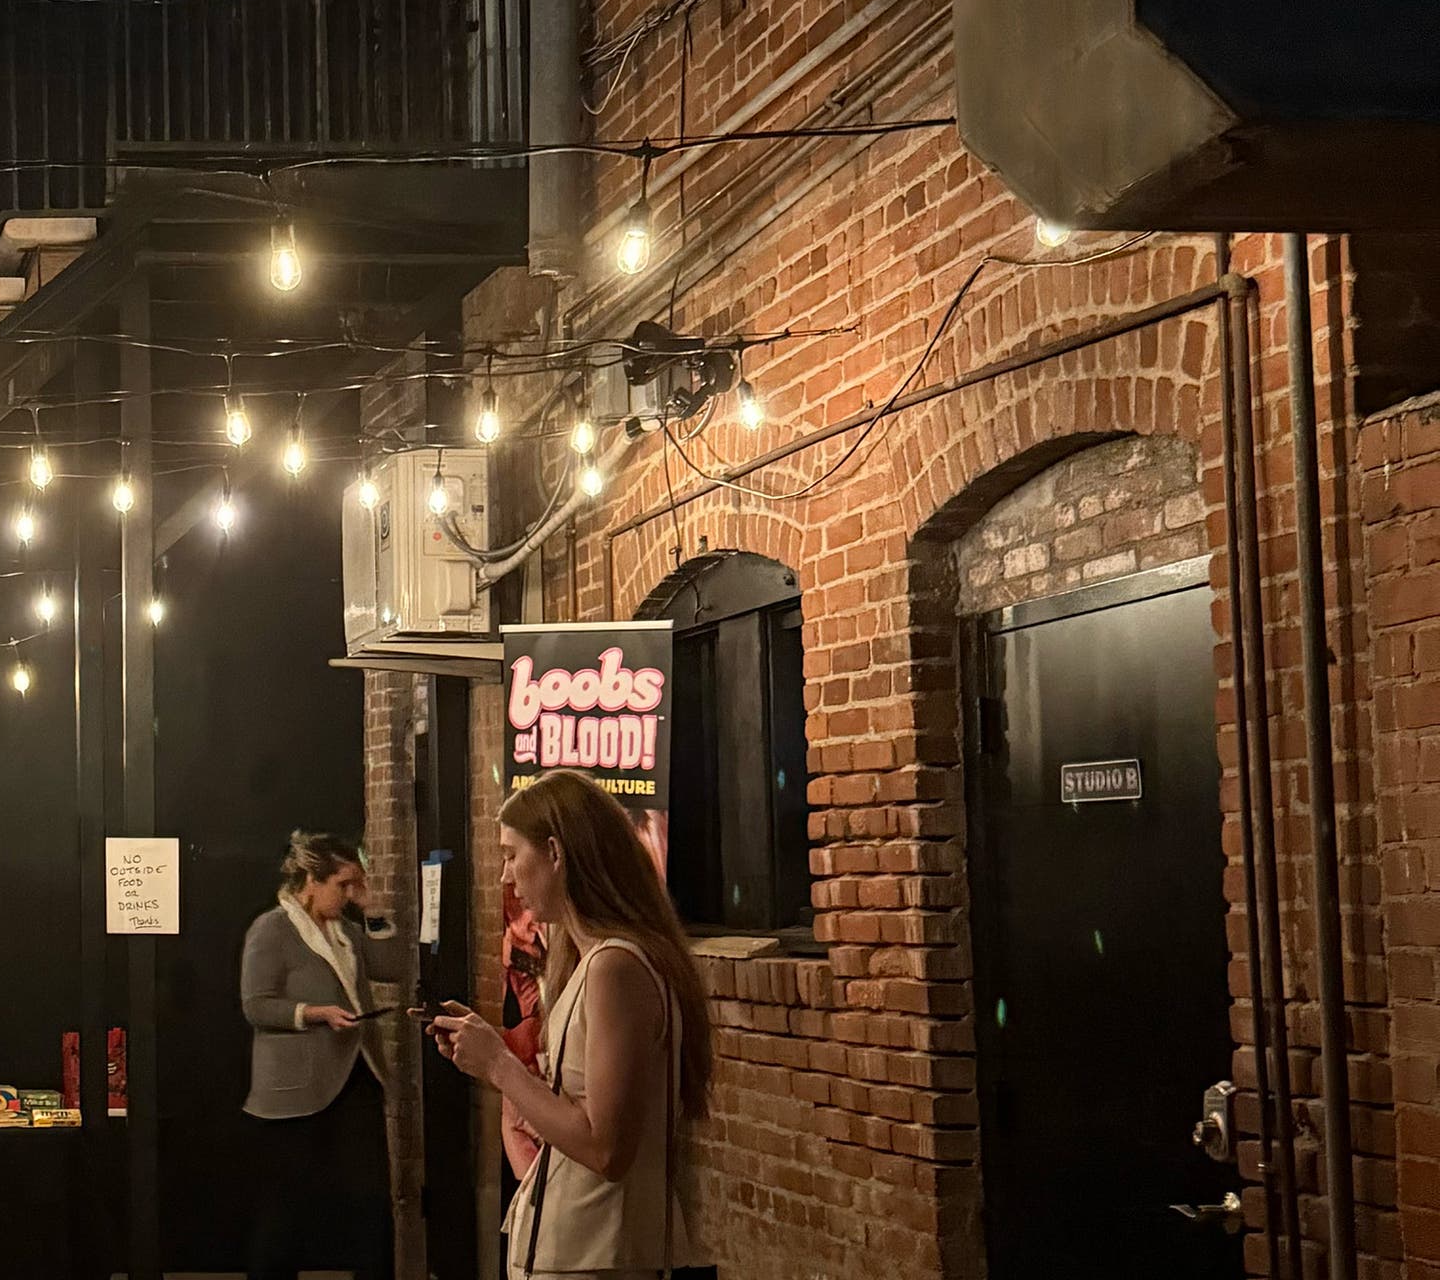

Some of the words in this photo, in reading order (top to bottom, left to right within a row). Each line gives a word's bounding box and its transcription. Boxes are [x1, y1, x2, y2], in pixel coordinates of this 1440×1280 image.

[508, 647, 665, 730] boobs
[514, 726, 537, 764] and
[539, 713, 658, 770] BLOOD!
[1064, 768, 1123, 793] STUDIO
[1125, 767, 1138, 790] B
[123, 855, 142, 865] NO
[110, 864, 167, 876] OUTSIDE
[118, 878, 143, 888] FOOD
[124, 890, 140, 898] OR
[118, 899, 160, 912] DRINKS
